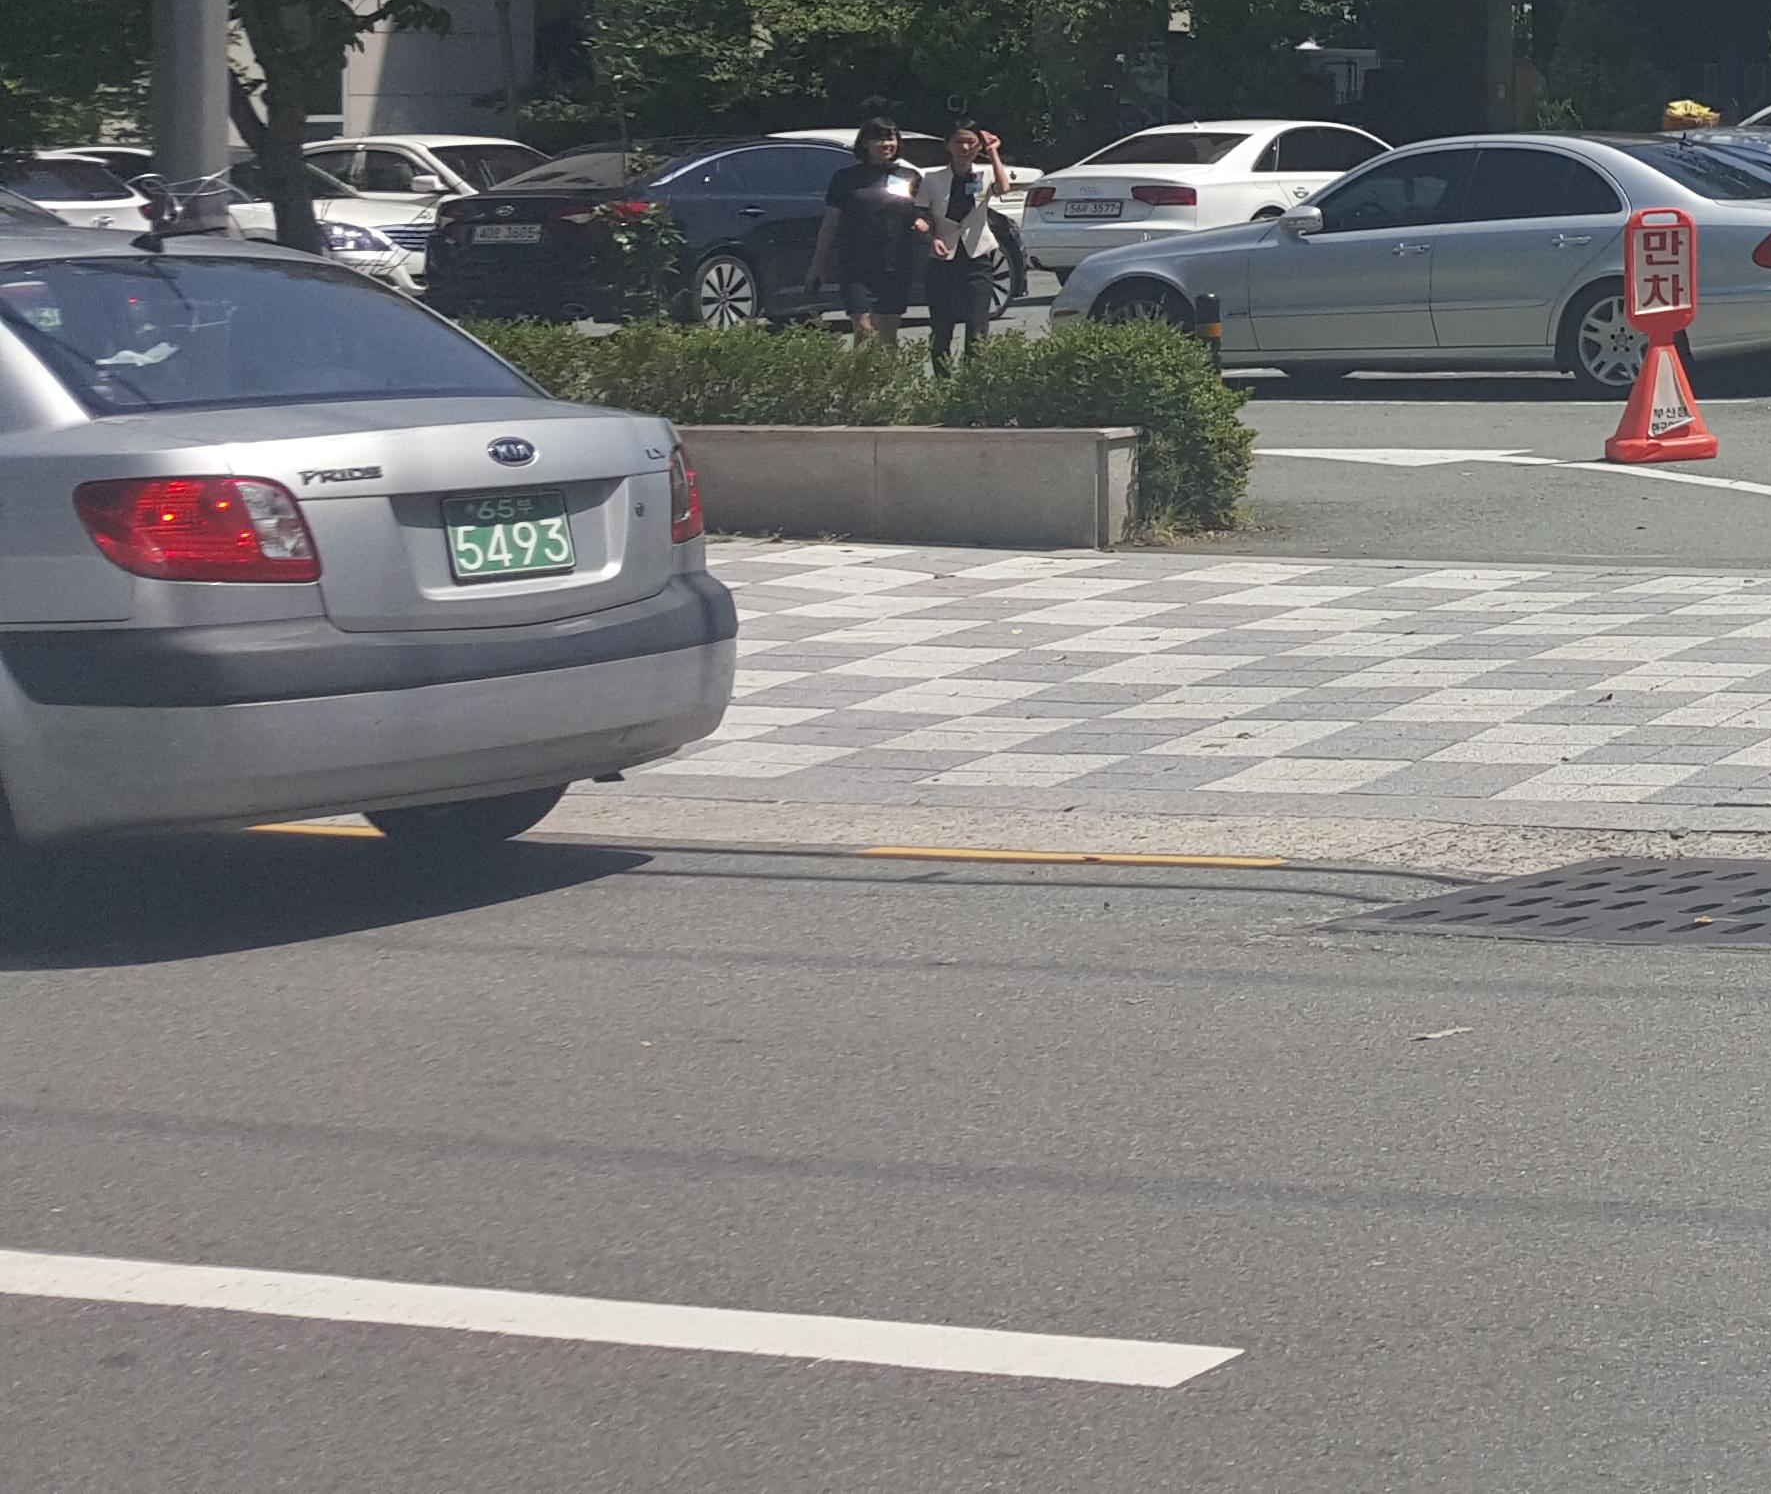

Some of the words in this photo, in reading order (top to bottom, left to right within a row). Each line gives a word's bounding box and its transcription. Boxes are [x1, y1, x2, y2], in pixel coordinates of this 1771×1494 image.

[1642, 231, 1684, 307] 만차
[495, 444, 532, 459] KIA
[298, 466, 383, 486] PRIDE
[456, 519, 569, 570] 5493
